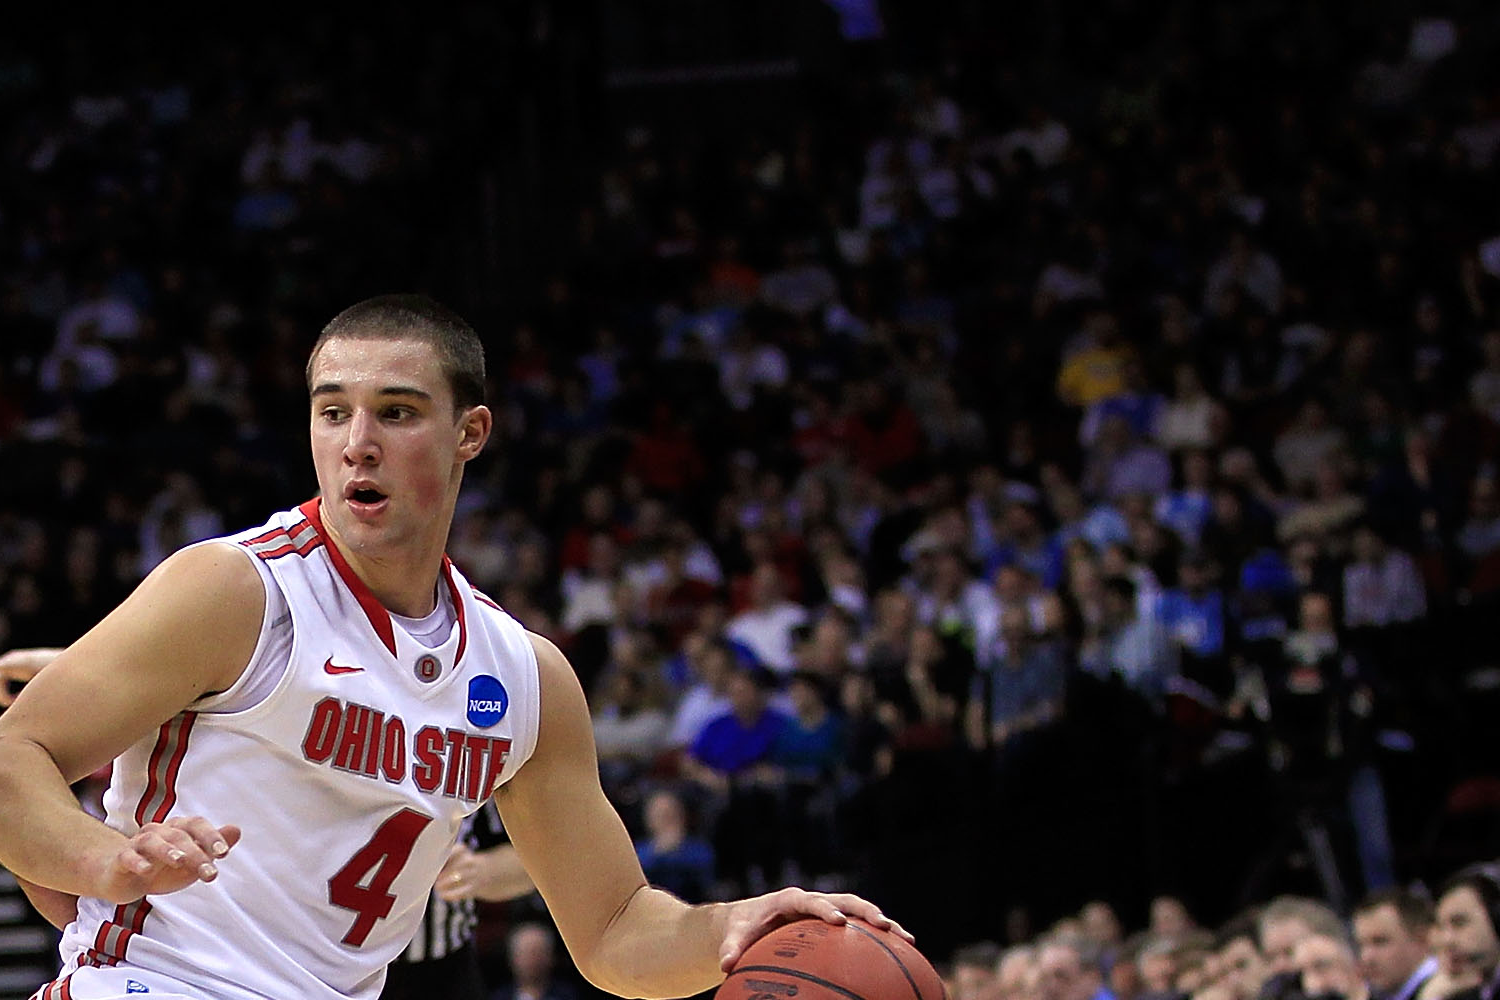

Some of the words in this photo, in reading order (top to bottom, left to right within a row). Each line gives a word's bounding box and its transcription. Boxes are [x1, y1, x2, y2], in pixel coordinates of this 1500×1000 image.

[301, 696, 406, 784] OHIO
[412, 724, 512, 803] STTE
[468, 699, 502, 713] NCAA
[328, 807, 434, 947] 4
